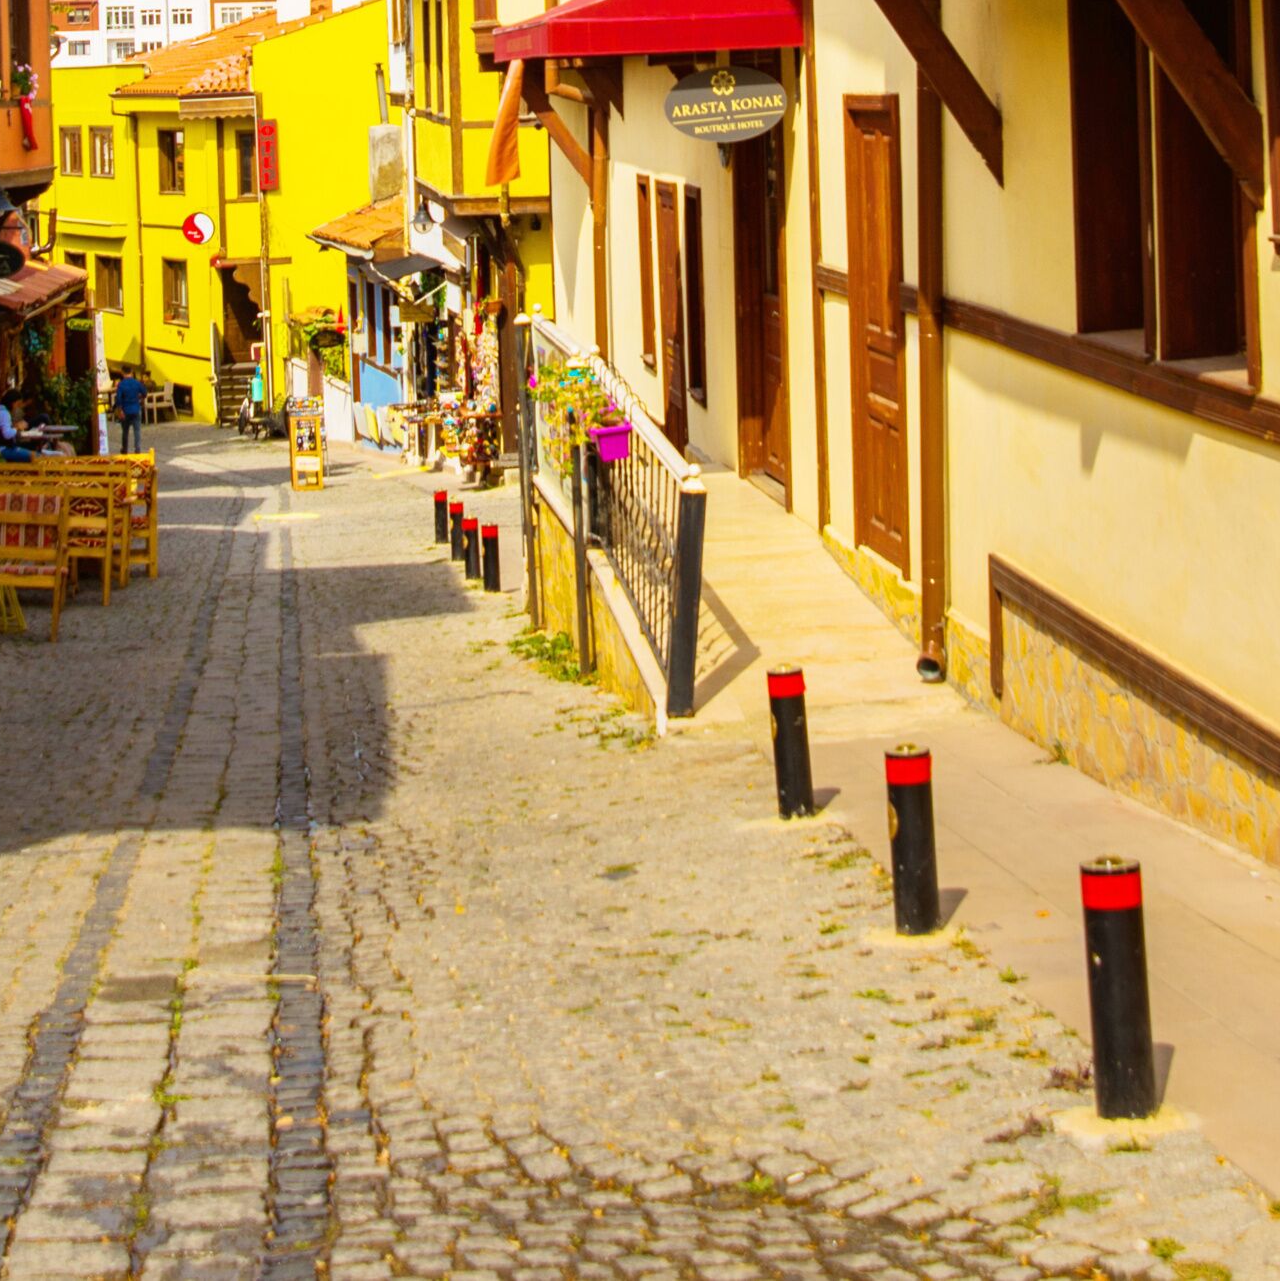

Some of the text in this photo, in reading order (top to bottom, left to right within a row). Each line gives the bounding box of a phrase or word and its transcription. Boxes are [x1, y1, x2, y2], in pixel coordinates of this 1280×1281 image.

[672, 94, 783, 118] ARASTA KONAK
[694, 119, 764, 134] BOUTIQUE HOTEL
